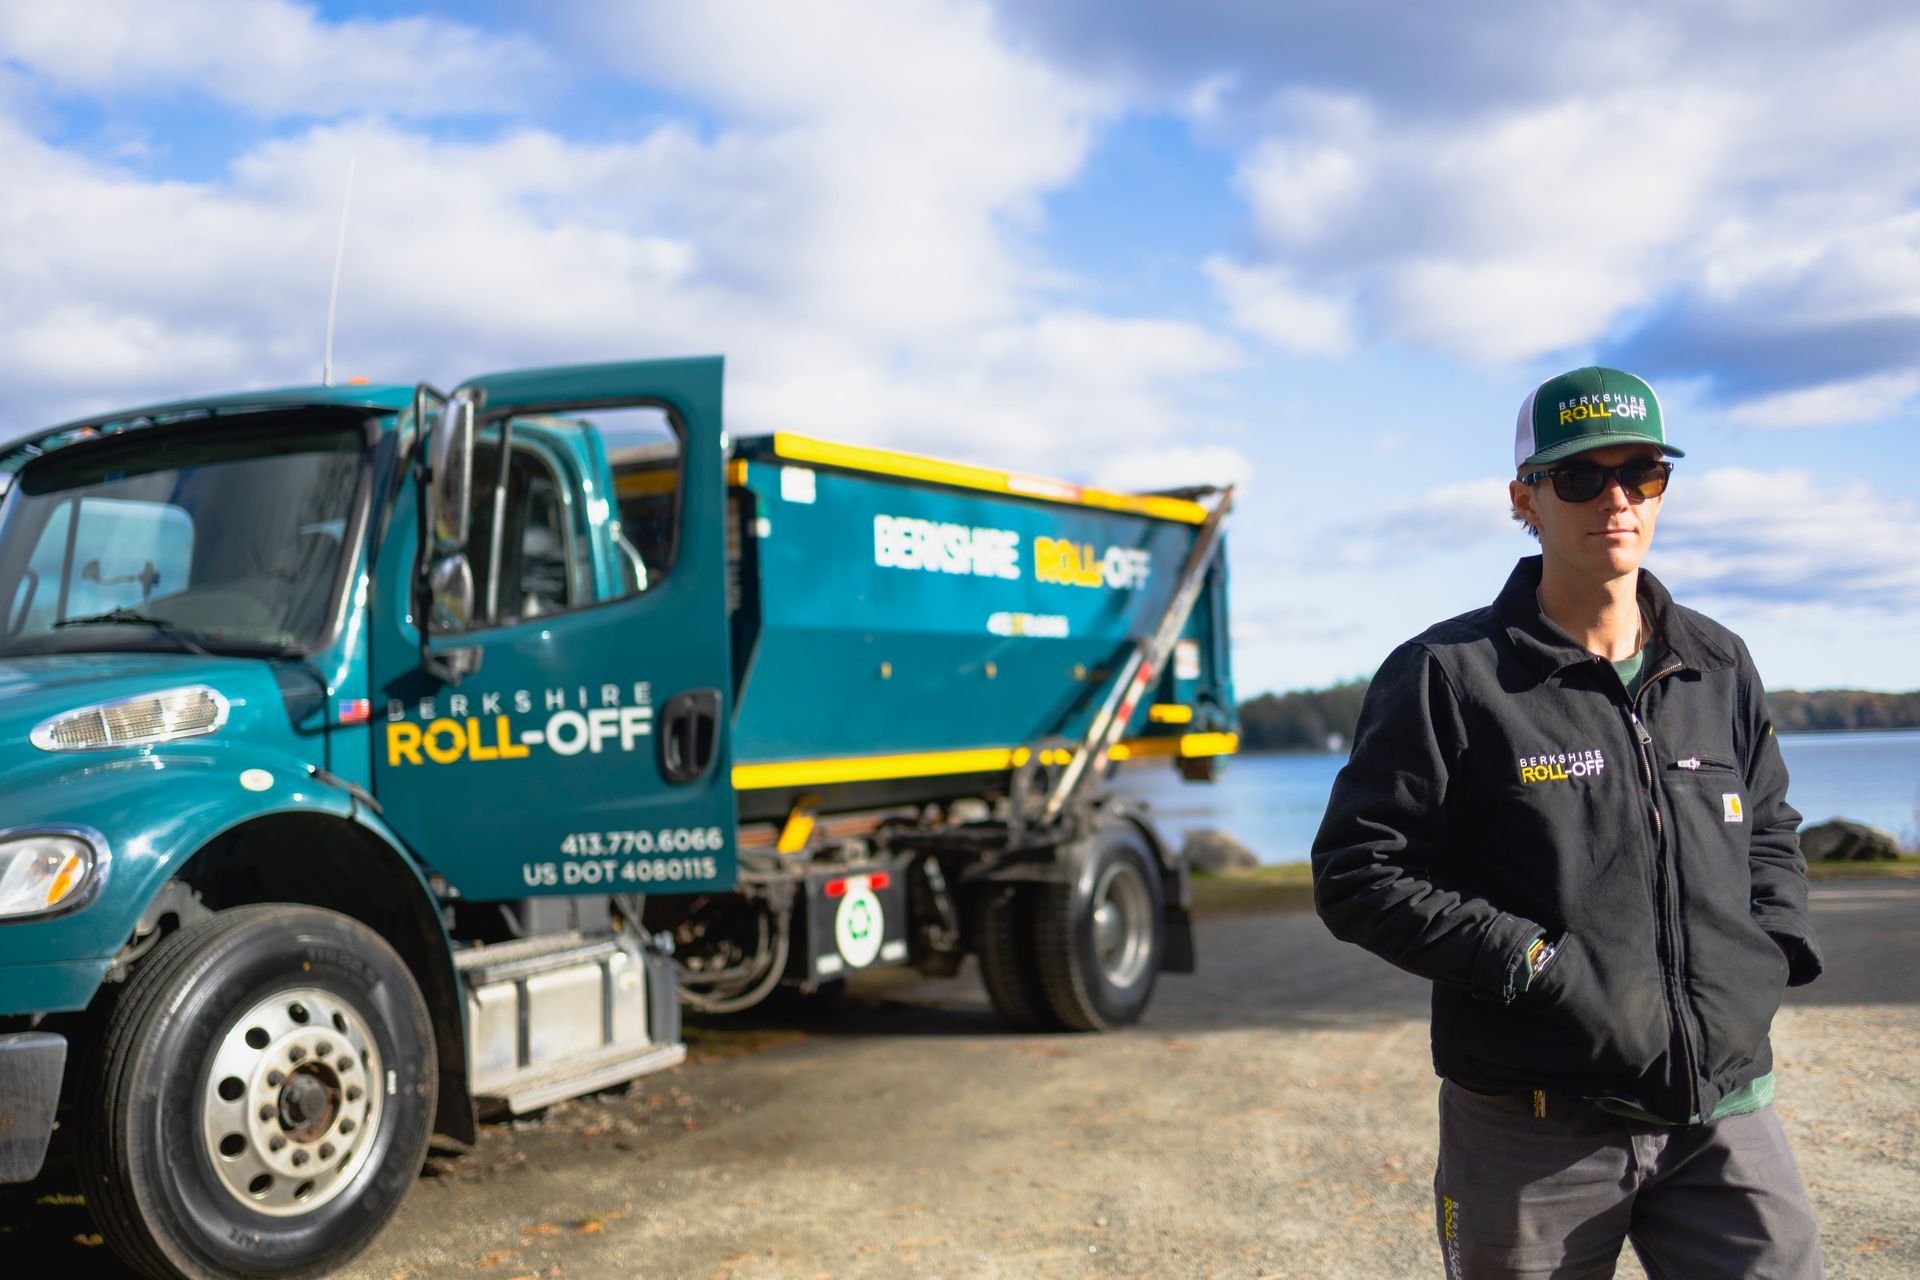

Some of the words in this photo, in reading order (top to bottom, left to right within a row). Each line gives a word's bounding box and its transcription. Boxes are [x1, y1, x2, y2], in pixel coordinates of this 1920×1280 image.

[1559, 393, 1645, 411] BERKSHIRE
[1560, 402, 1647, 426] ROLL-OFF
[874, 514, 1020, 580] BERKSHIRE
[1034, 536, 1152, 591] ROLL-OFF
[387, 681, 652, 721] BERKSHIRE
[386, 705, 653, 767] ROLL-OFF
[1519, 749, 1603, 768] BERKSHIRE
[1521, 758, 1604, 783] ROLL-OFF
[560, 826, 723, 857] 413.770.6066
[523, 862, 558, 886] US
[562, 860, 618, 885] DOT
[620, 857, 717, 881] 4080115
